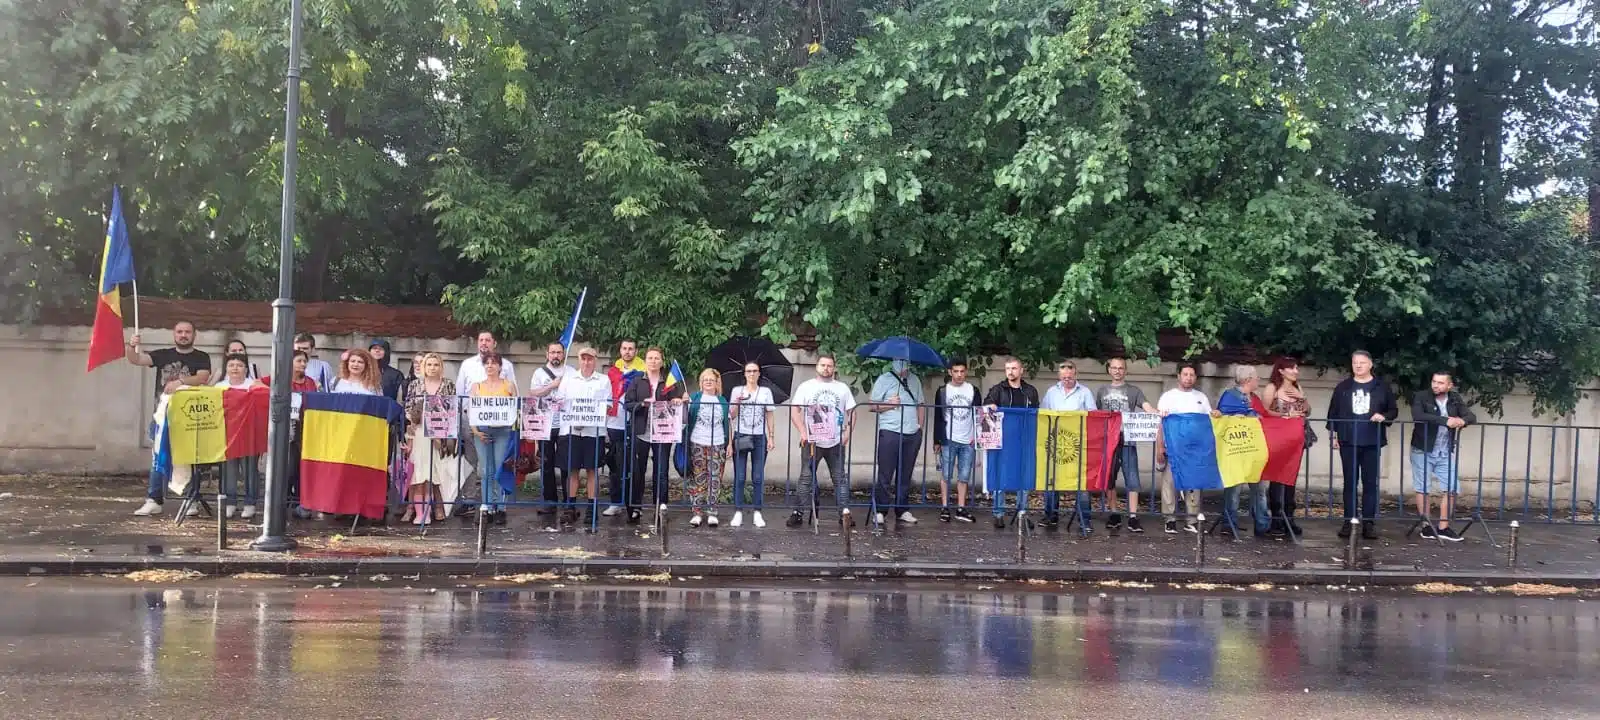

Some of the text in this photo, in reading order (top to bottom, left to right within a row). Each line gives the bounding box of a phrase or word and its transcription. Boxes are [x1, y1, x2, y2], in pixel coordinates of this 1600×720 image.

[471, 397, 482, 407] NU
[484, 397, 494, 407] NE
[188, 404, 210, 414] AUR
[478, 411, 500, 421] COPIII
[1229, 431, 1248, 440] AUR
